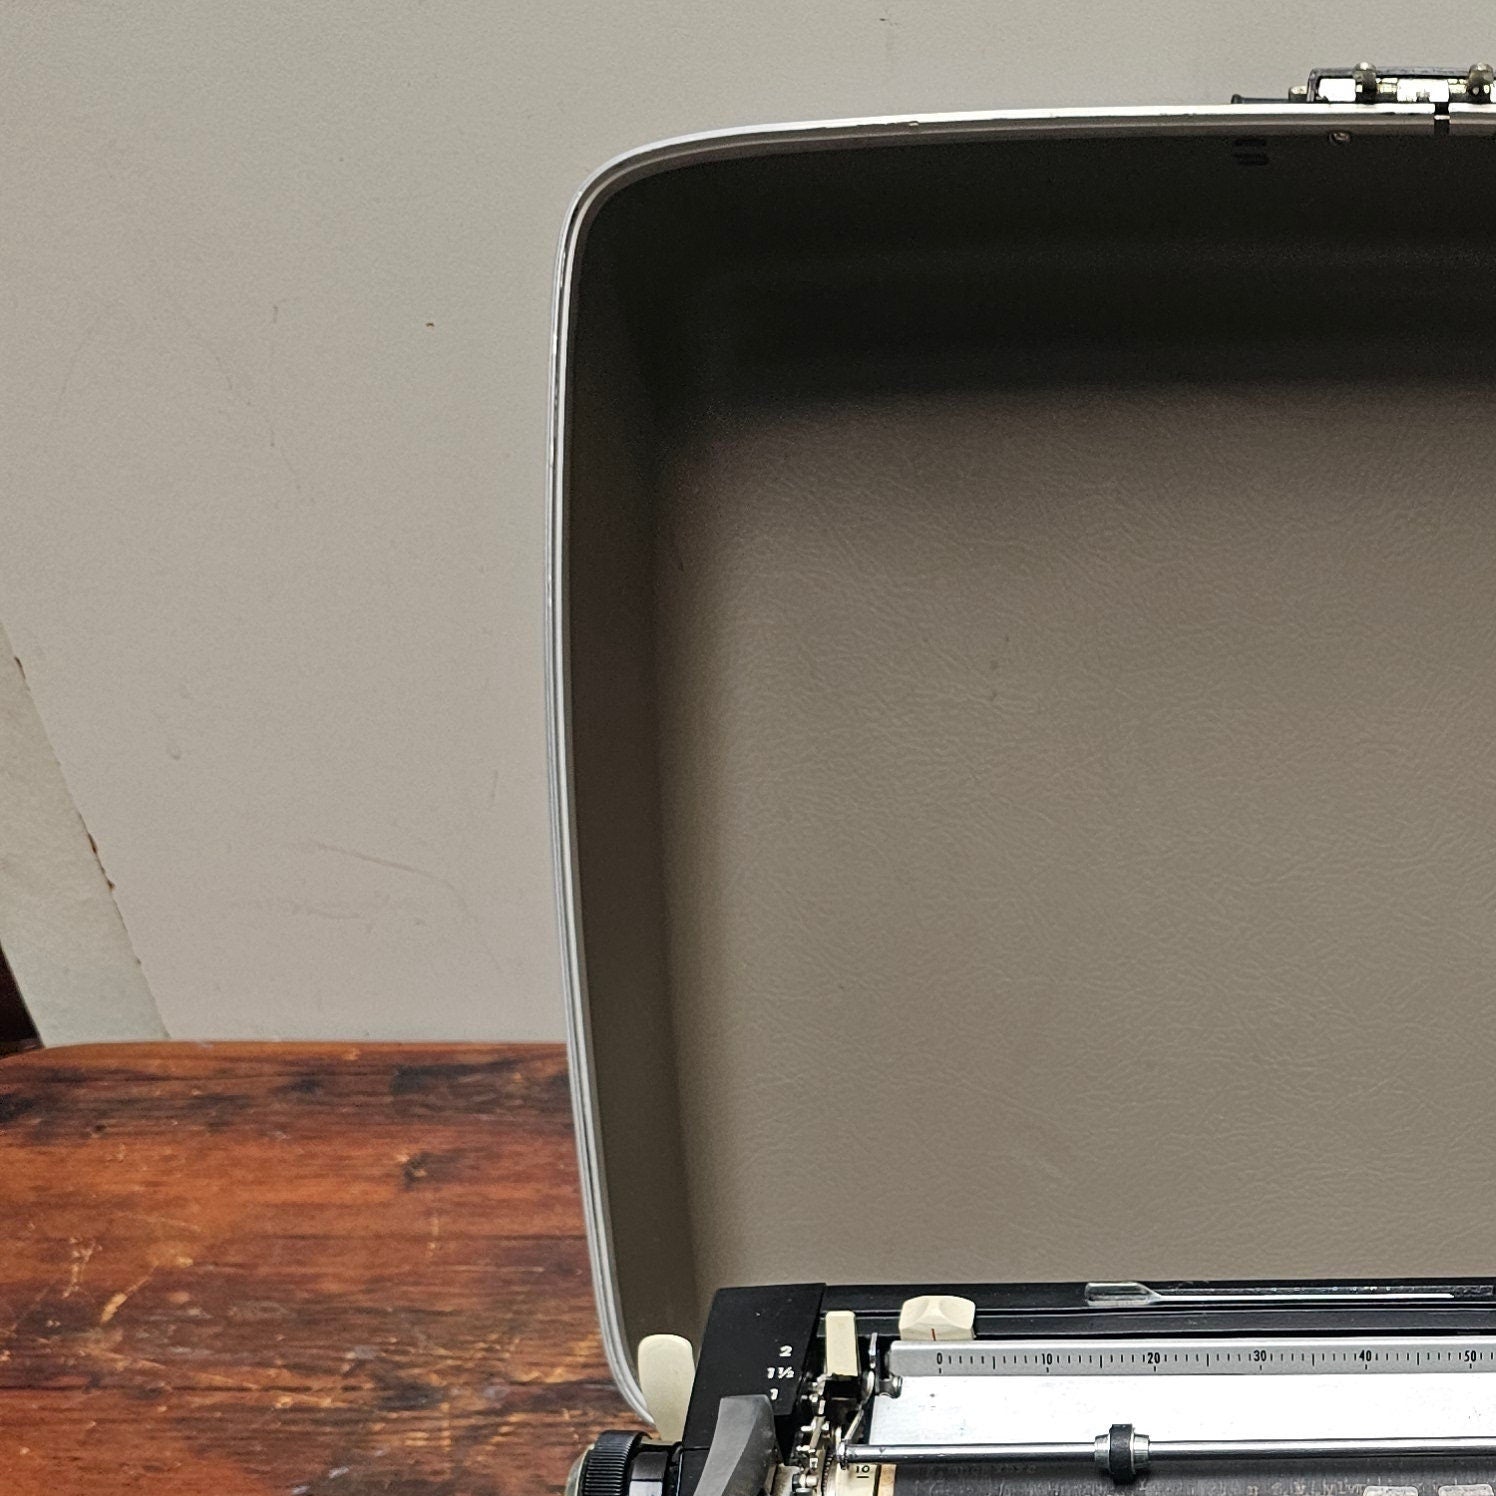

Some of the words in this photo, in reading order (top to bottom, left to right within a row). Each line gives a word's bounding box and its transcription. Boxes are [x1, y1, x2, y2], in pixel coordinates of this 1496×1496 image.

[779, 1345, 792, 1357] 2
[1042, 1353, 1052, 1364] 10
[1147, 1352, 1160, 1364] 20
[1254, 1350, 1266, 1362] 30
[1359, 1350, 1372, 1362] 40
[1464, 1350, 1476, 1362] 50
[770, 1389, 778, 1400] 1
[856, 1465, 870, 1473] 10
